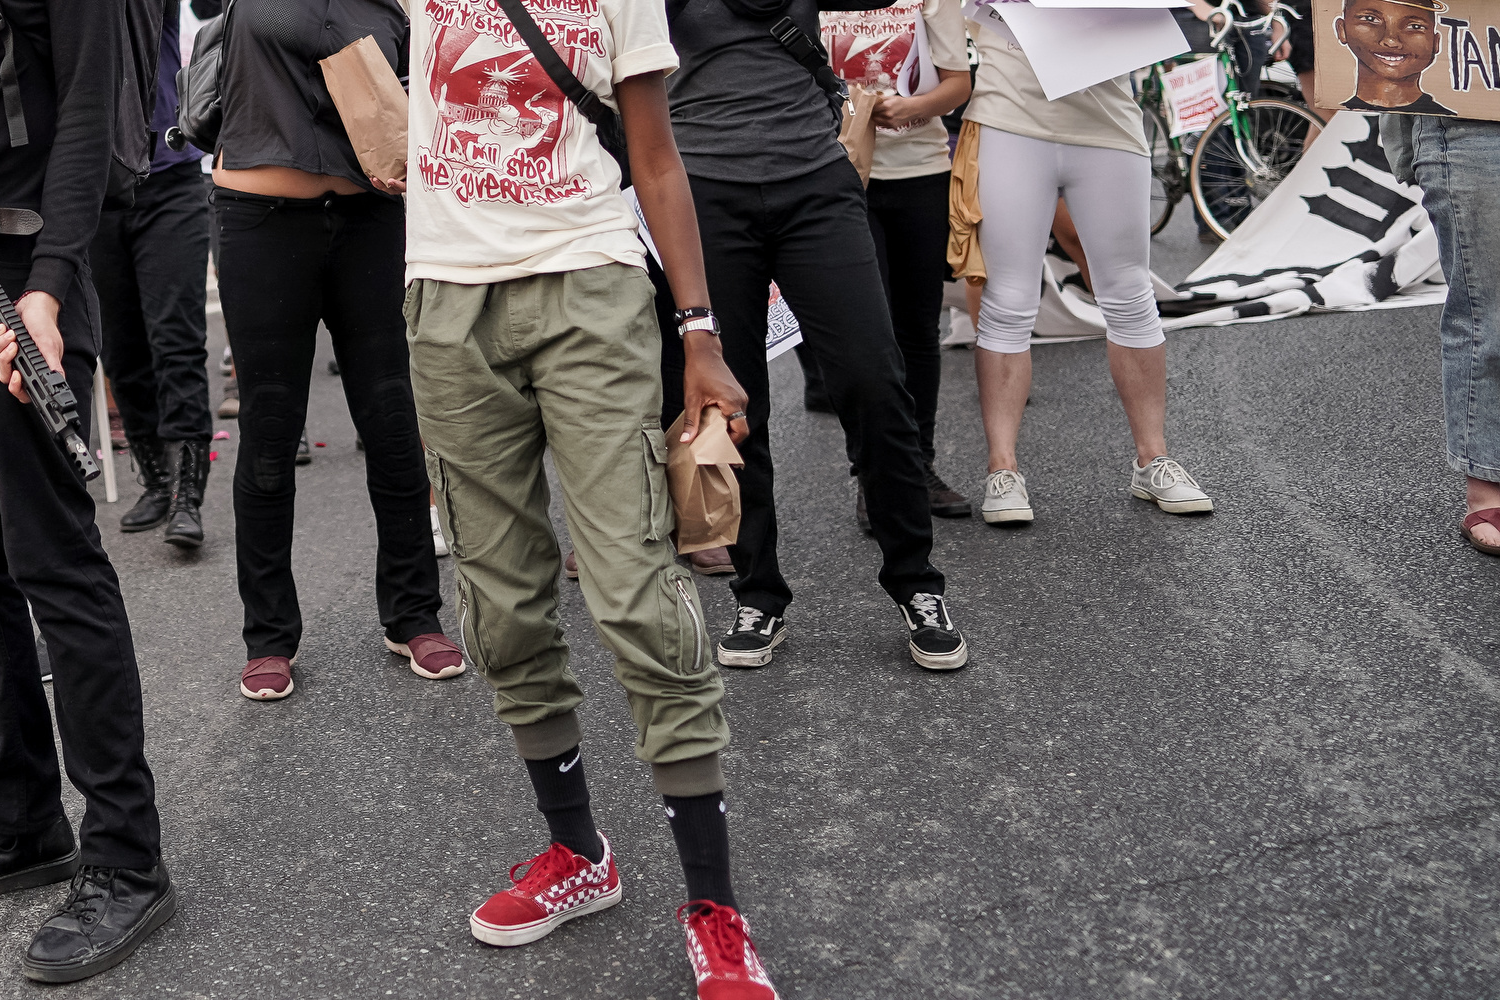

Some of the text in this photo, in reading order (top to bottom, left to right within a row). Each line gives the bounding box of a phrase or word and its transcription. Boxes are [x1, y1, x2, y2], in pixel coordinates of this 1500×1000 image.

[474, 16, 513, 47] stop
[853, 22, 876, 37] stop
[881, 21, 904, 34] the
[419, 154, 449, 187] the
[507, 155, 549, 185] stop
